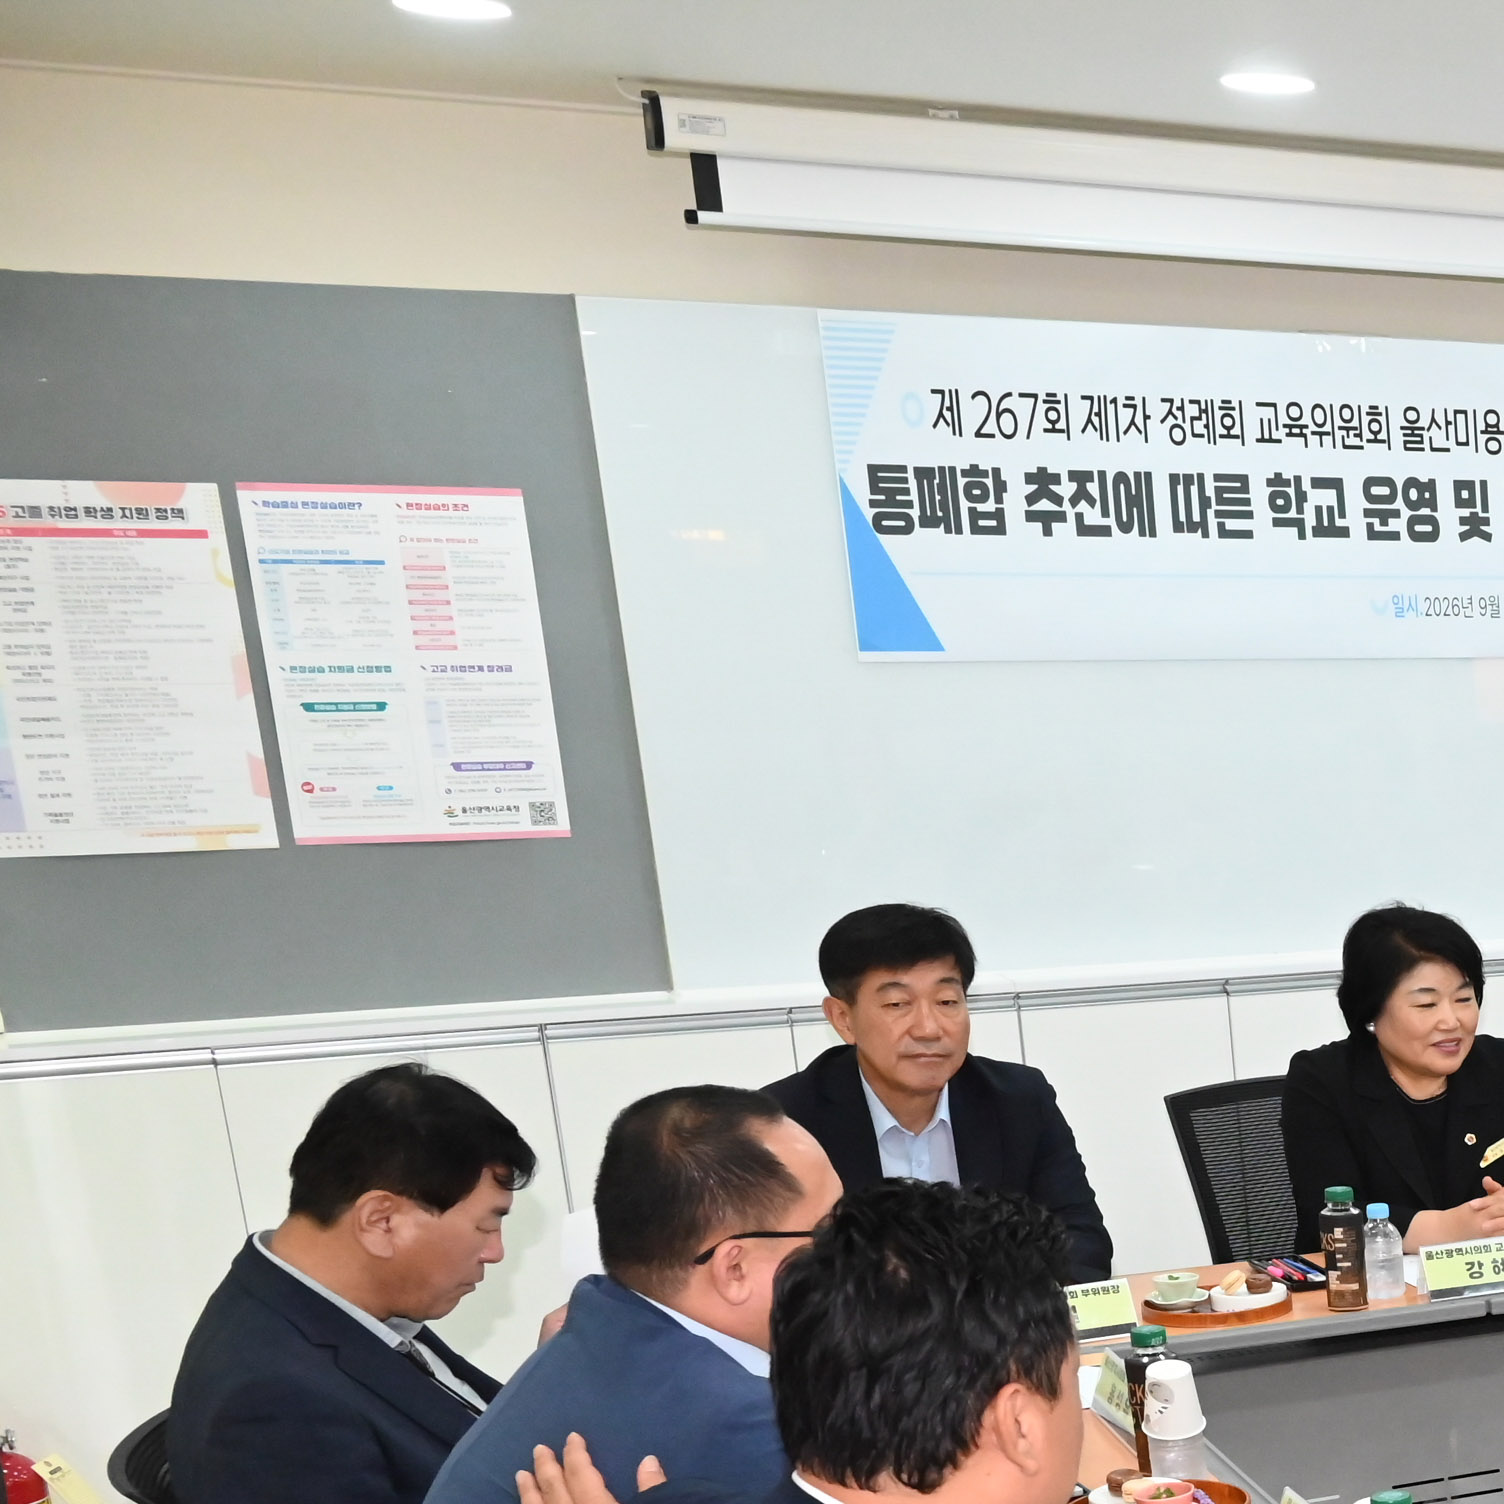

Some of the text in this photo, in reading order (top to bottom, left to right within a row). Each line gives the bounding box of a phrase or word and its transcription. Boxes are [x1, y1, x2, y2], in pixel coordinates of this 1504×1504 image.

[929, 388, 963, 438] 제
[970, 389, 1072, 442] 267회
[1080, 394, 1151, 444] 제1차
[1159, 397, 1246, 447] 정례회
[1254, 401, 1392, 451] 교육위원회
[46, 505, 80, 521] 취업
[83, 506, 116, 521] 학생
[118, 506, 151, 522] 지원
[153, 506, 187, 522] 정책
[866, 462, 1008, 537] 통폐합
[1023, 466, 1157, 539] 추진에
[1168, 470, 1255, 540] 따른
[1265, 471, 1351, 541] 학교
[1361, 475, 1442, 544] 운영
[1452, 478, 1495, 544] 및
[1477, 595, 1501, 619] 9월
[1424, 1243, 1493, 1261] 울산광역시의회
[1081, 1284, 1121, 1298] 부위원장
